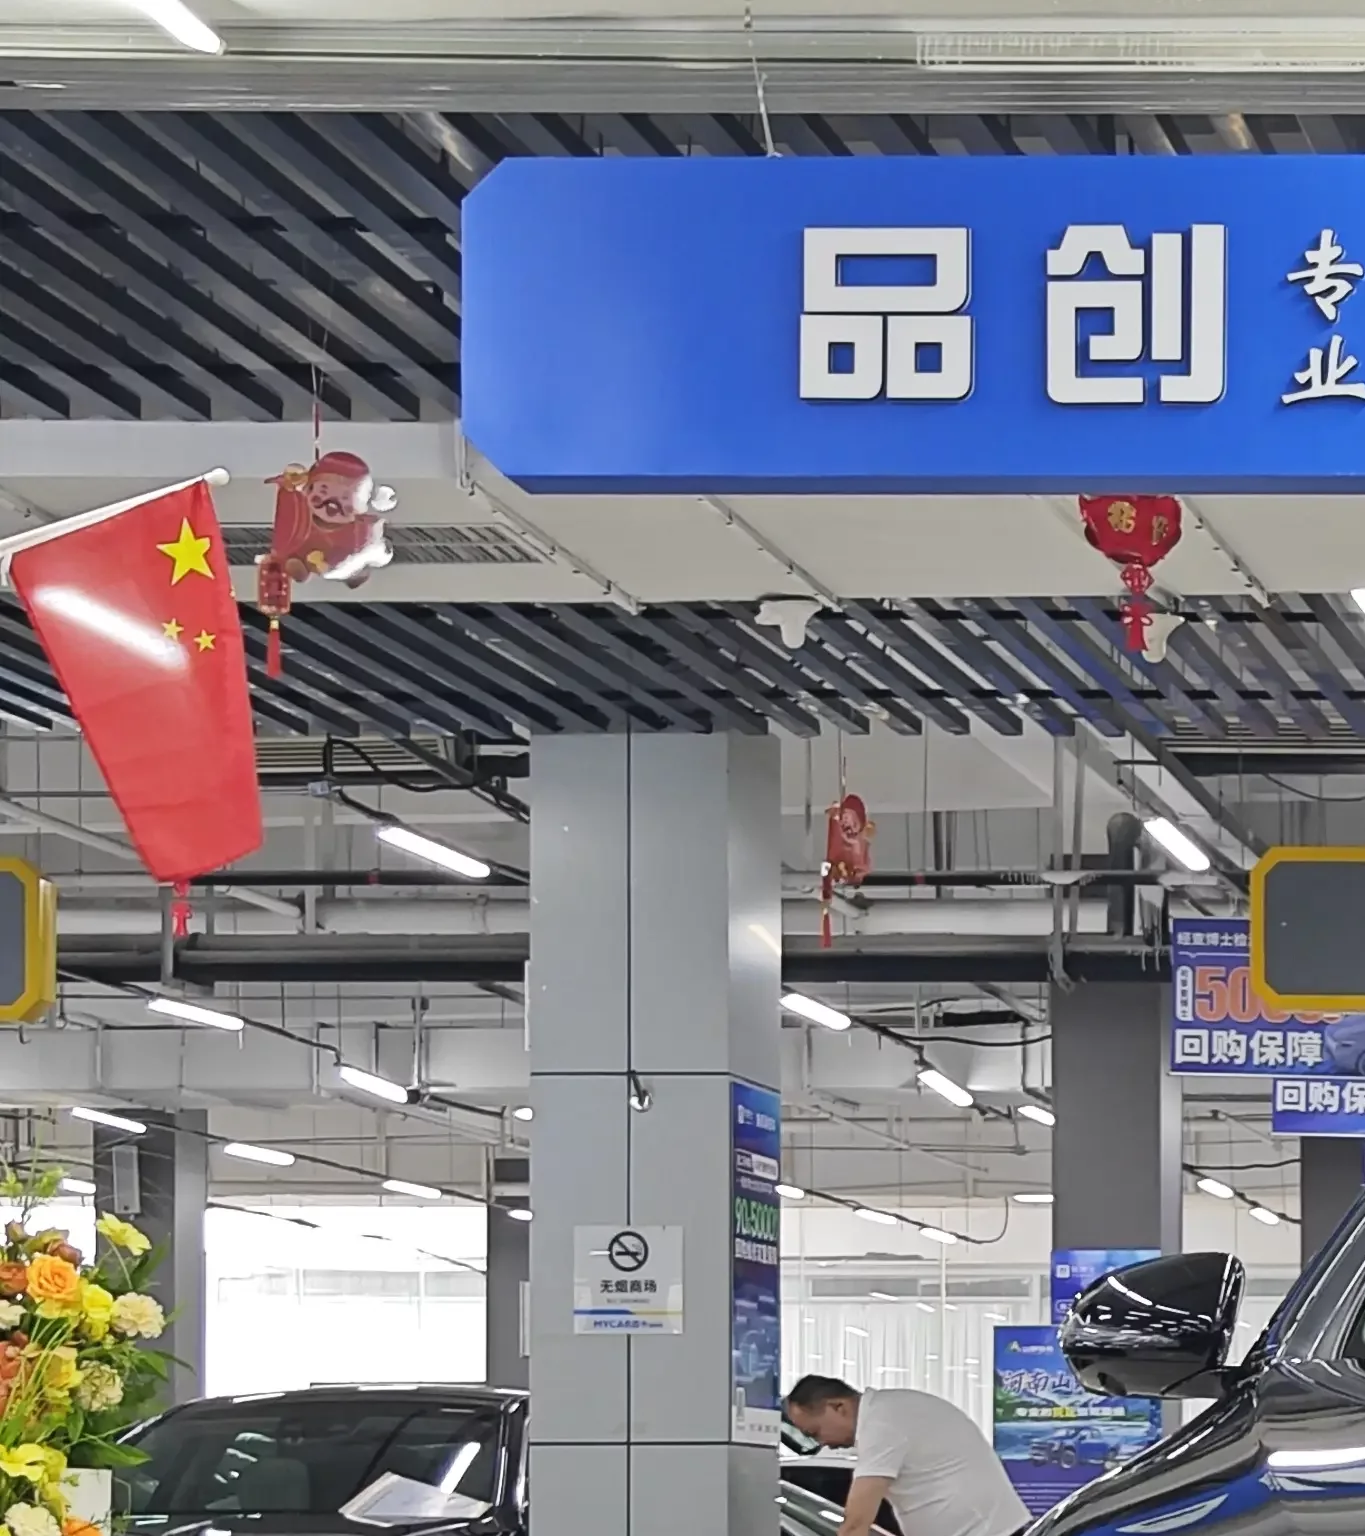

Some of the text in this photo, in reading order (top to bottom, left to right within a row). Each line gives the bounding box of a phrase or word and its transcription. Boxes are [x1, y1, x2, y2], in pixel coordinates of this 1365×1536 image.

[799, 223, 1226, 405] 品创
[1174, 1028, 1324, 1067] 回购保障
[600, 1279, 657, 1293] 无烟商场
[1003, 1368, 1083, 1394] 河南山
